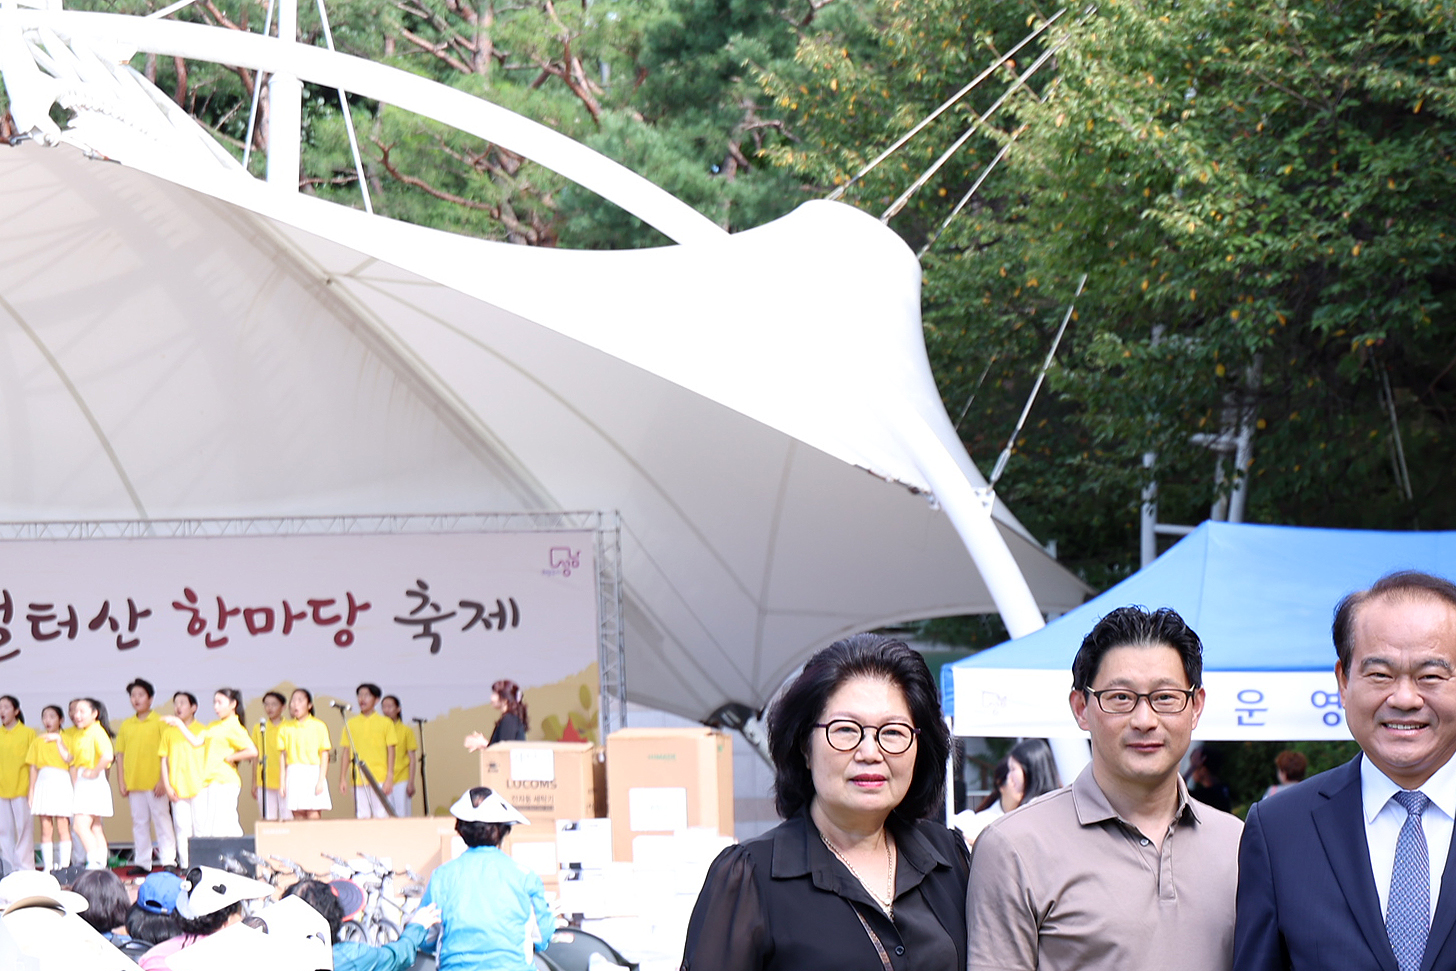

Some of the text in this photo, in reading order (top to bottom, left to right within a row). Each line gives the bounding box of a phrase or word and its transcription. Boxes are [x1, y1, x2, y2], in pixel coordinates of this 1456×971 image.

[172, 587, 372, 650] 한마당
[393, 579, 521, 655] 축제
[506, 778, 557, 789] LUCOMS
